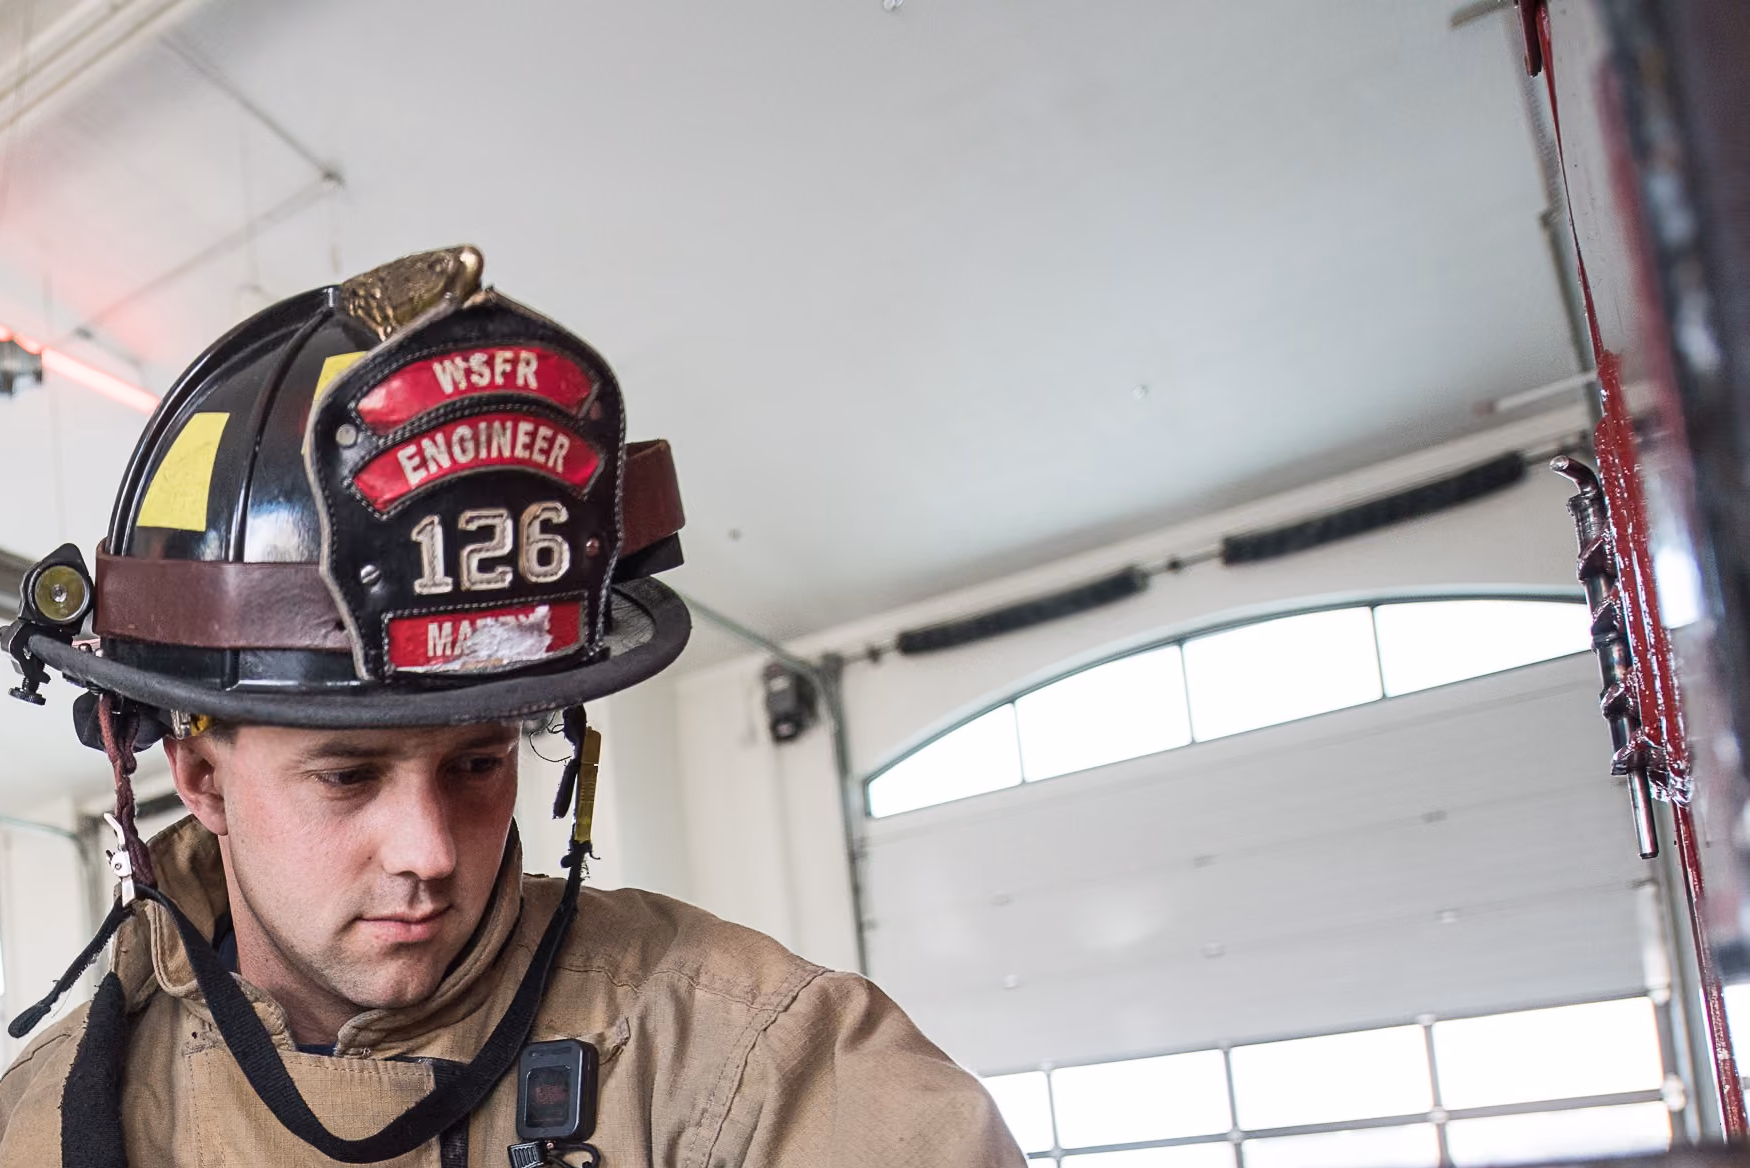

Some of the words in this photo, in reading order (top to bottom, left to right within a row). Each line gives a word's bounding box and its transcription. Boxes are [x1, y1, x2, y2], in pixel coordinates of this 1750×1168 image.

[432, 350, 539, 396] WSFR
[397, 420, 571, 488] ENGINEER
[411, 501, 571, 596] 126
